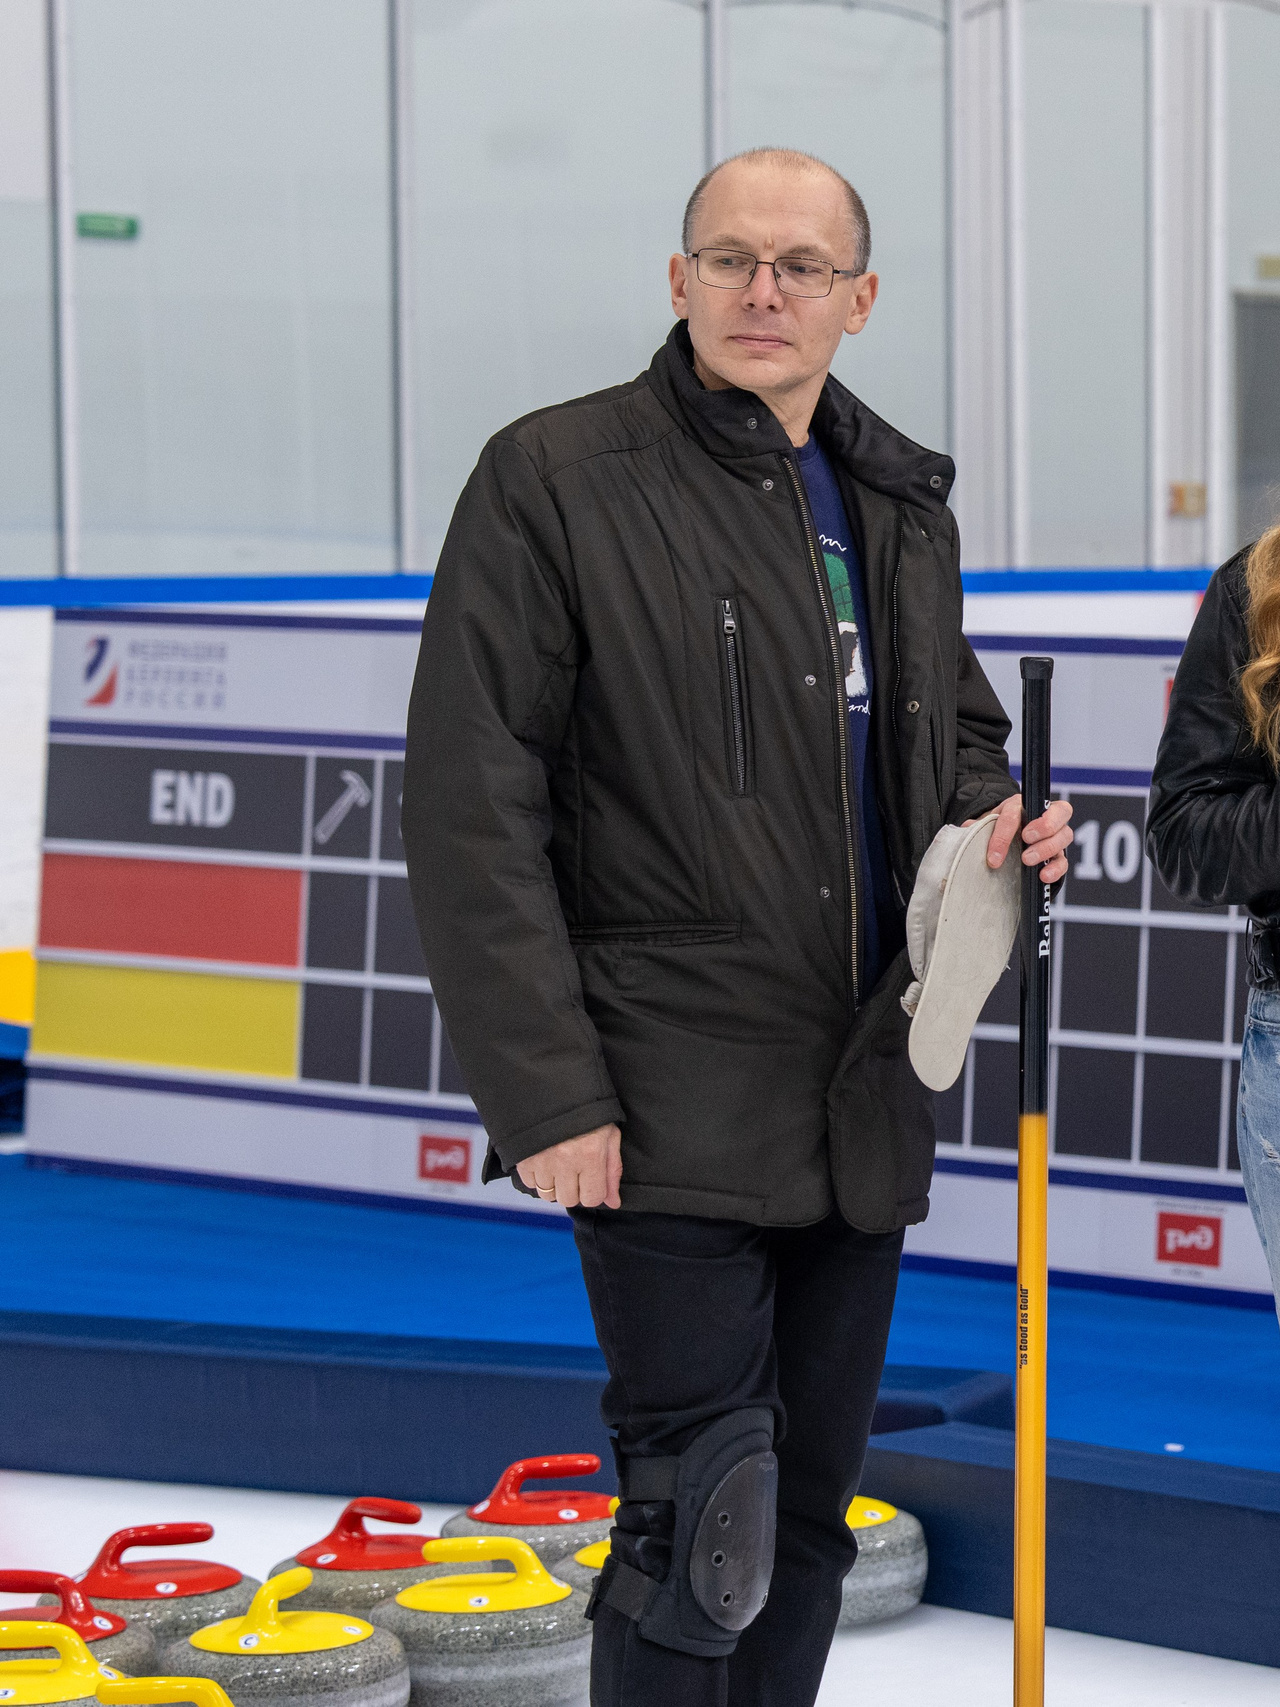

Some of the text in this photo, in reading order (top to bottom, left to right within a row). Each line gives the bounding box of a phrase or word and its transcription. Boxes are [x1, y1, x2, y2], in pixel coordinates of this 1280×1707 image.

[151, 769, 235, 828] END
[1074, 820, 1141, 883] 10
[1019, 1326, 1028, 1351] Good
[1020, 1312, 1028, 1325] as
